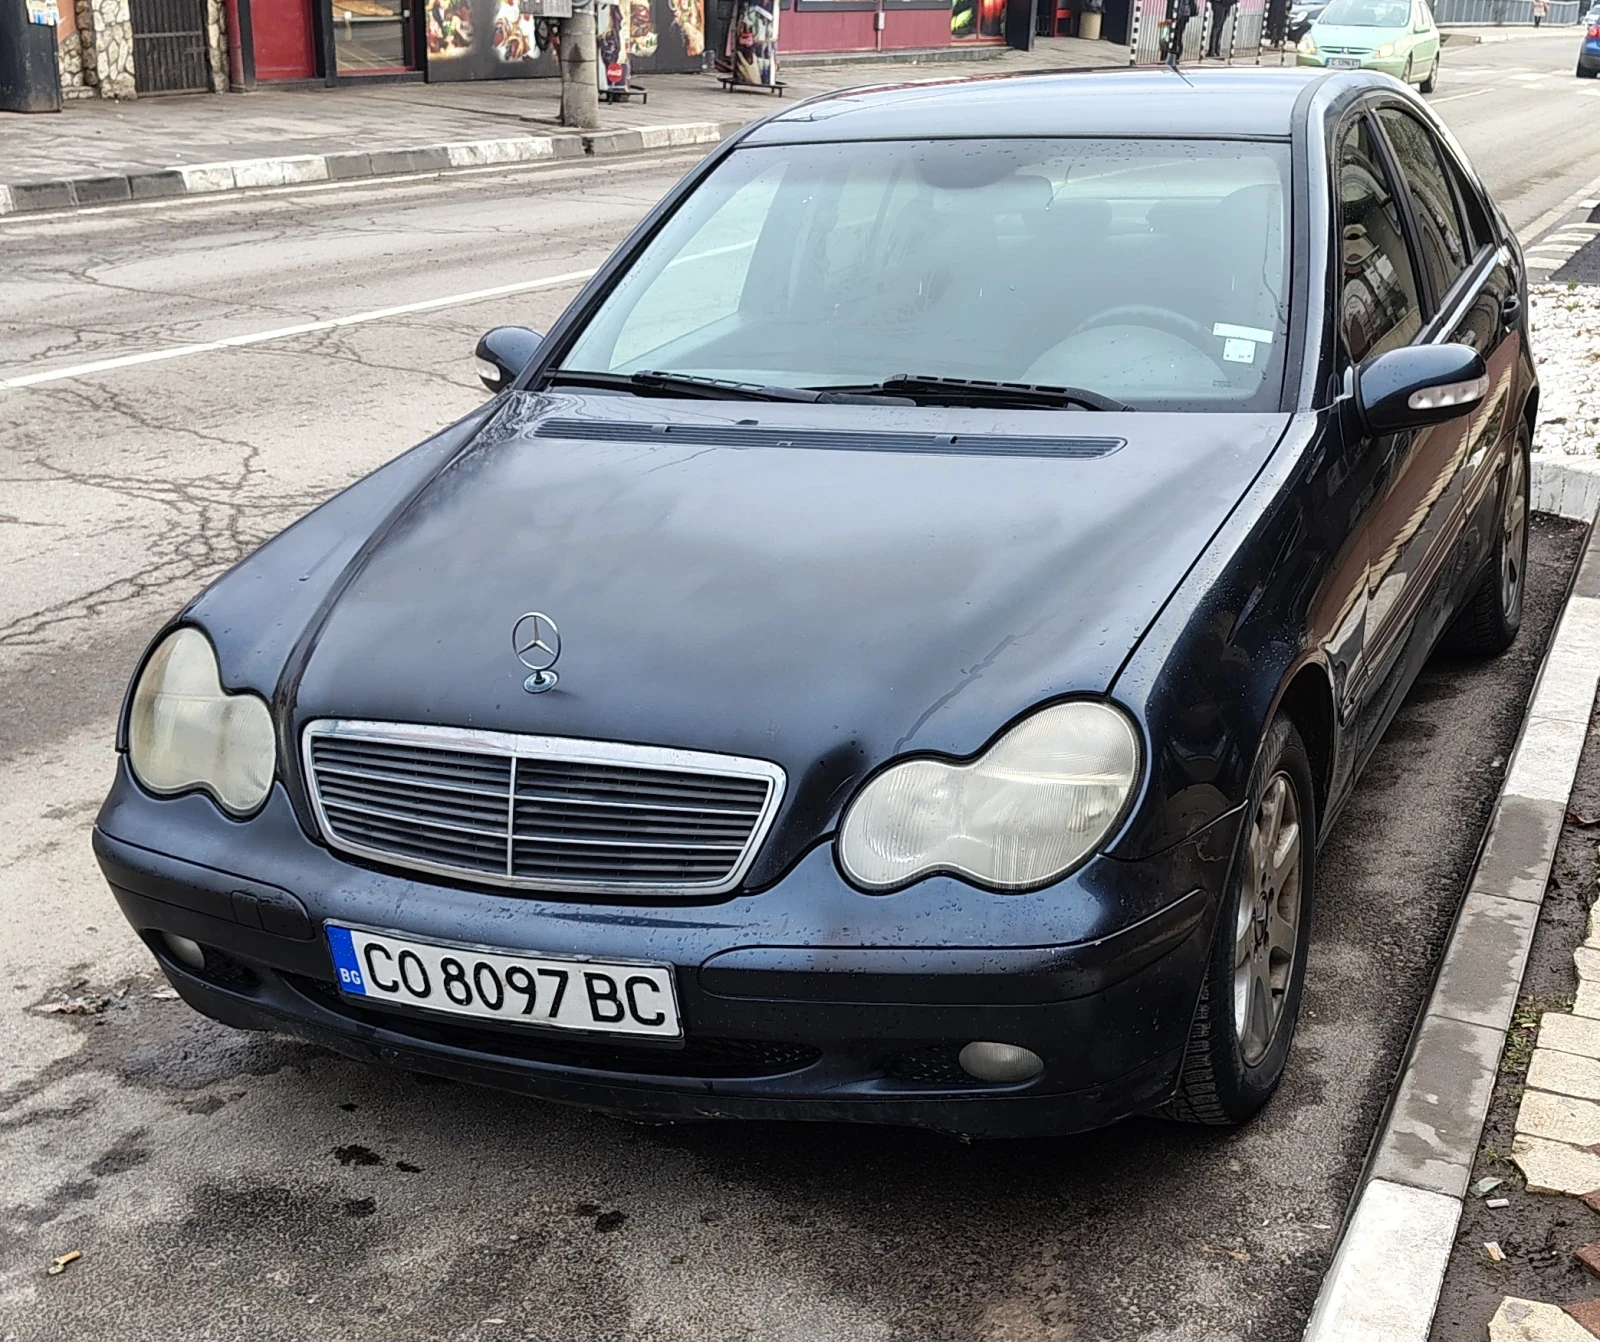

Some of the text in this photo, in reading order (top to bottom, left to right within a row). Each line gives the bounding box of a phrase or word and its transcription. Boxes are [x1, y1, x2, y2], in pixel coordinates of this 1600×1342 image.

[340, 967, 361, 985] BG
[364, 943, 665, 1027] CO 8097 BC
